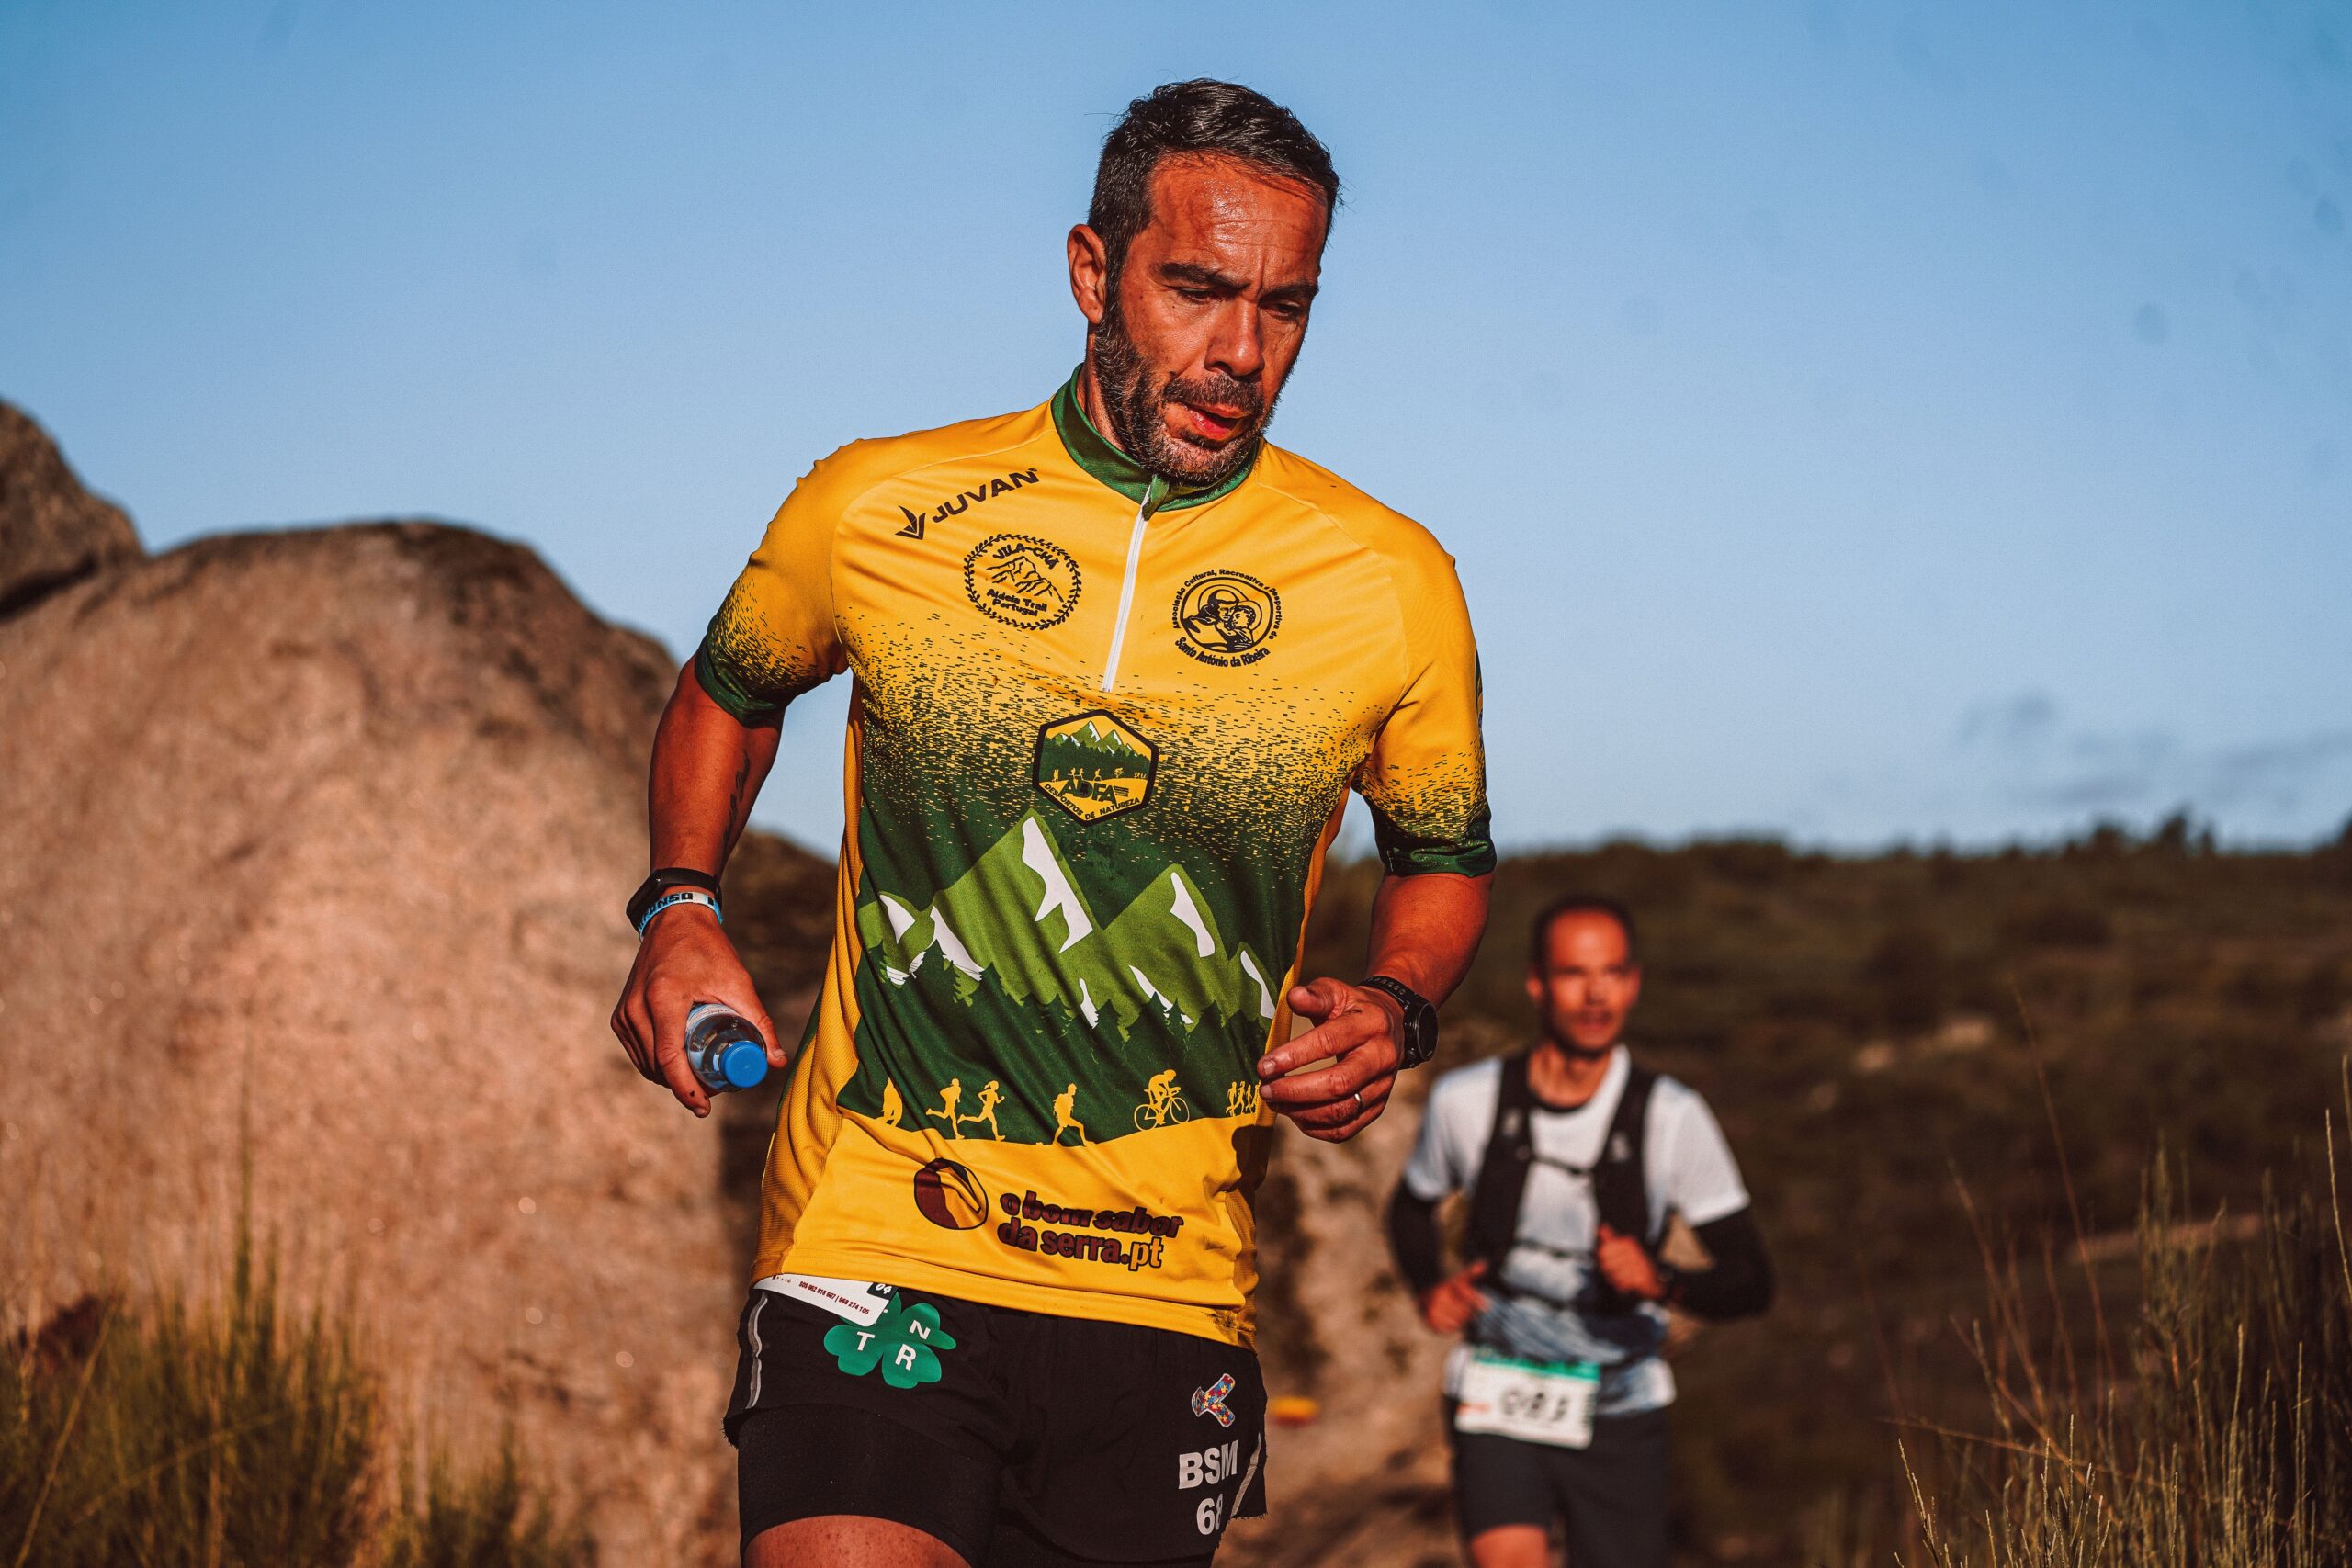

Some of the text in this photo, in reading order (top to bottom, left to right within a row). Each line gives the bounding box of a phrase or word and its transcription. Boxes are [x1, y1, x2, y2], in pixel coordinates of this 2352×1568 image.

[932, 471, 1040, 524] JUVAN
[1219, 569, 1264, 588] Recreativa
[992, 598, 1038, 617] Portugal
[1023, 598, 1048, 612] Trail
[1174, 637, 1272, 667] Santo António da Ribeira
[1084, 811, 1096, 820] DE
[1099, 797, 1141, 816] NATUREZA
[1022, 1190, 1094, 1227] bom
[1092, 1206, 1185, 1239] sabor
[997, 1216, 1165, 1272] da serra.pt
[848, 1301, 860, 1311] 274
[859, 1306, 871, 1315] 105
[856, 1331, 876, 1352] T
[909, 1319, 932, 1340] N
[895, 1343, 917, 1371] R
[1178, 1439, 1239, 1490] BSM
[1196, 1493, 1224, 1535] 68
